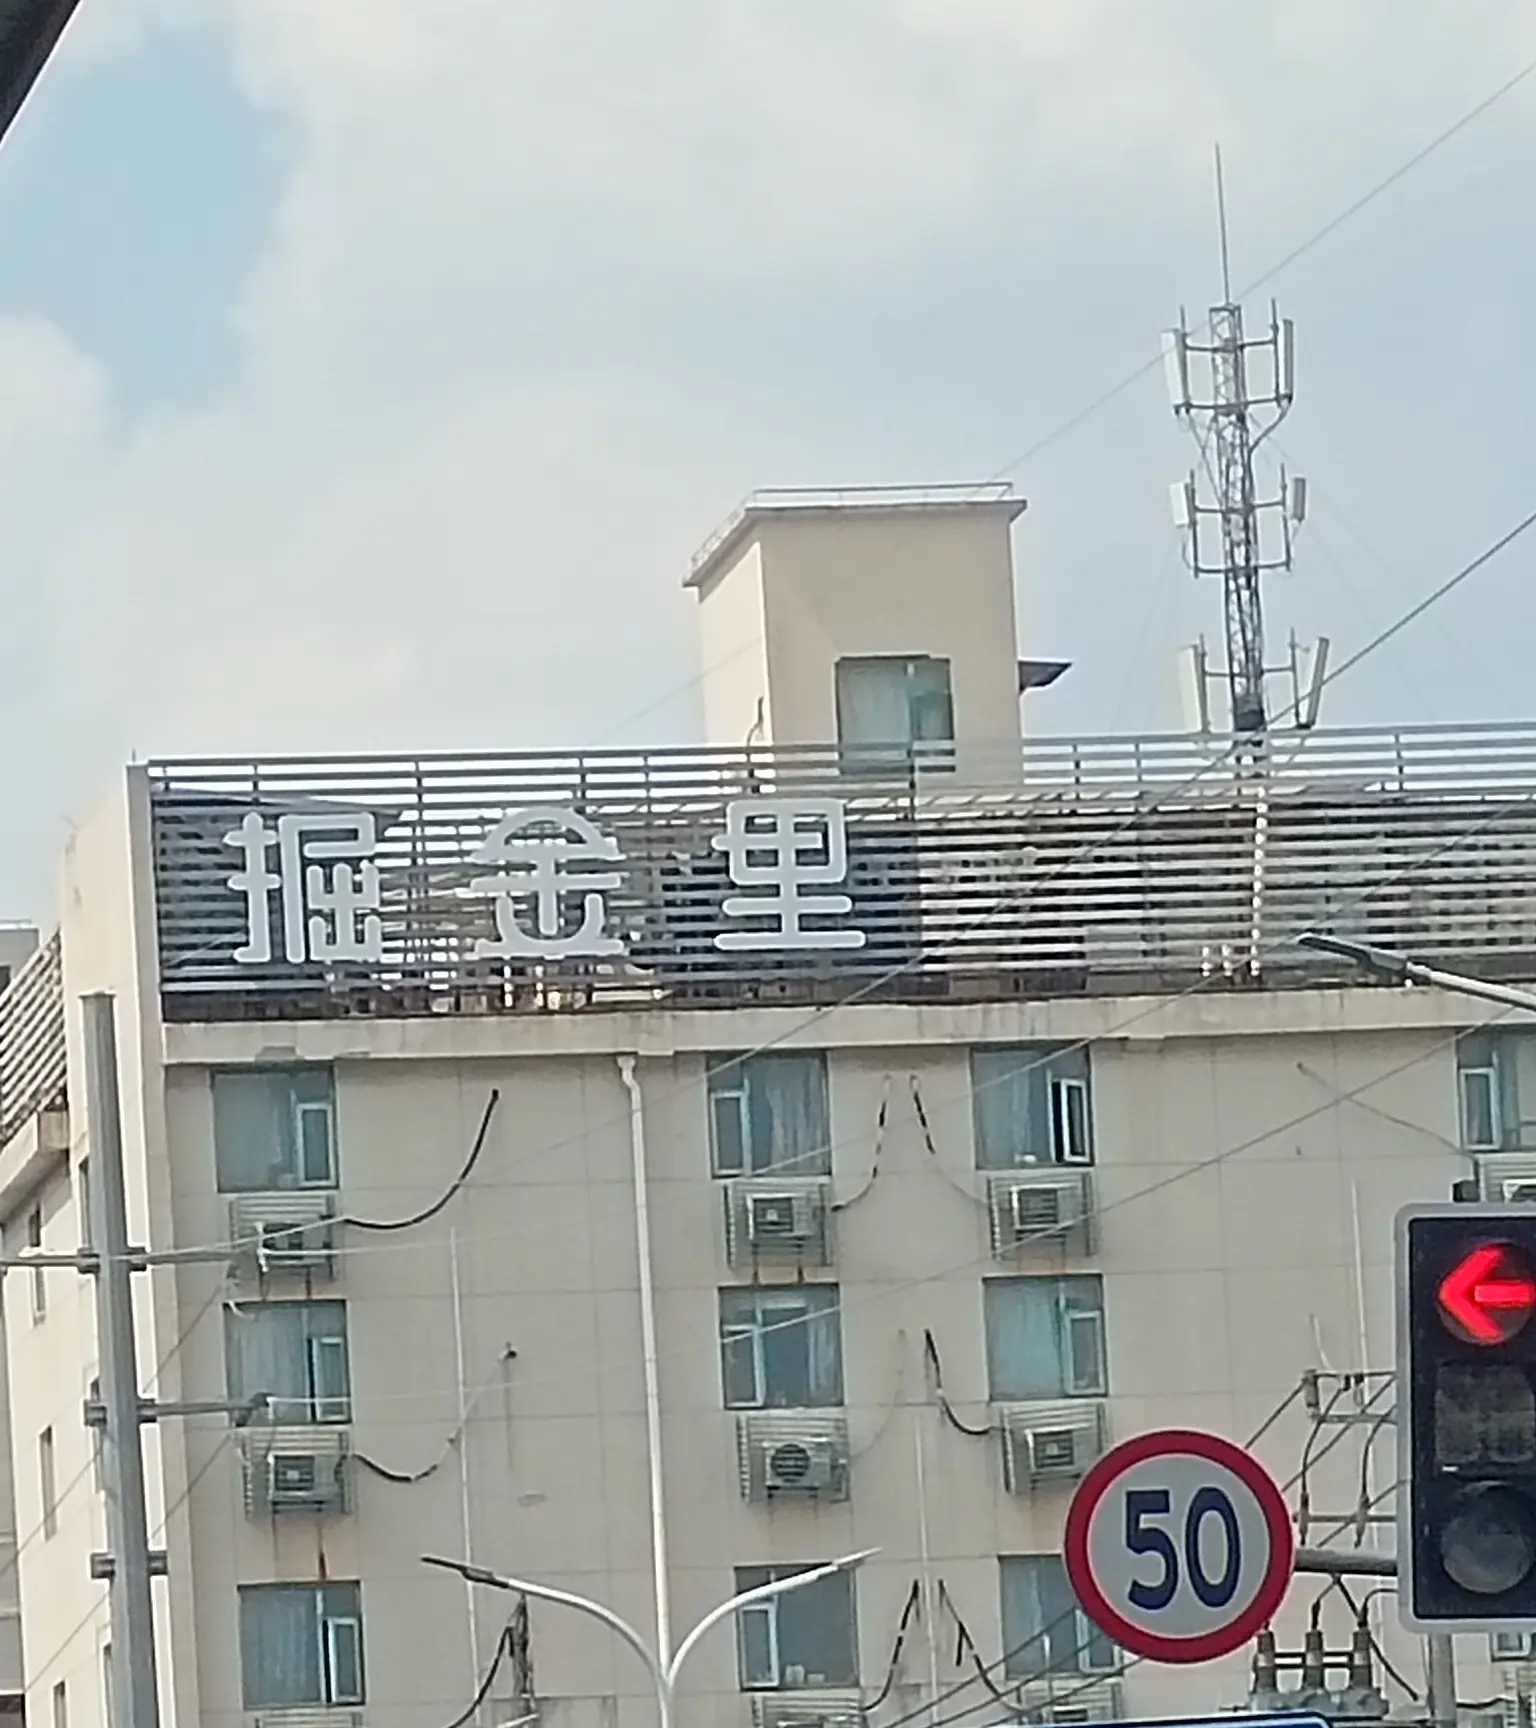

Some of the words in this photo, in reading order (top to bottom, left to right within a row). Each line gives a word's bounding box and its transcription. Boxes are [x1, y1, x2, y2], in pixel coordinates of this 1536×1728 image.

[223, 799, 865, 964] 掘金里
[1123, 1487, 1241, 1610] 50
